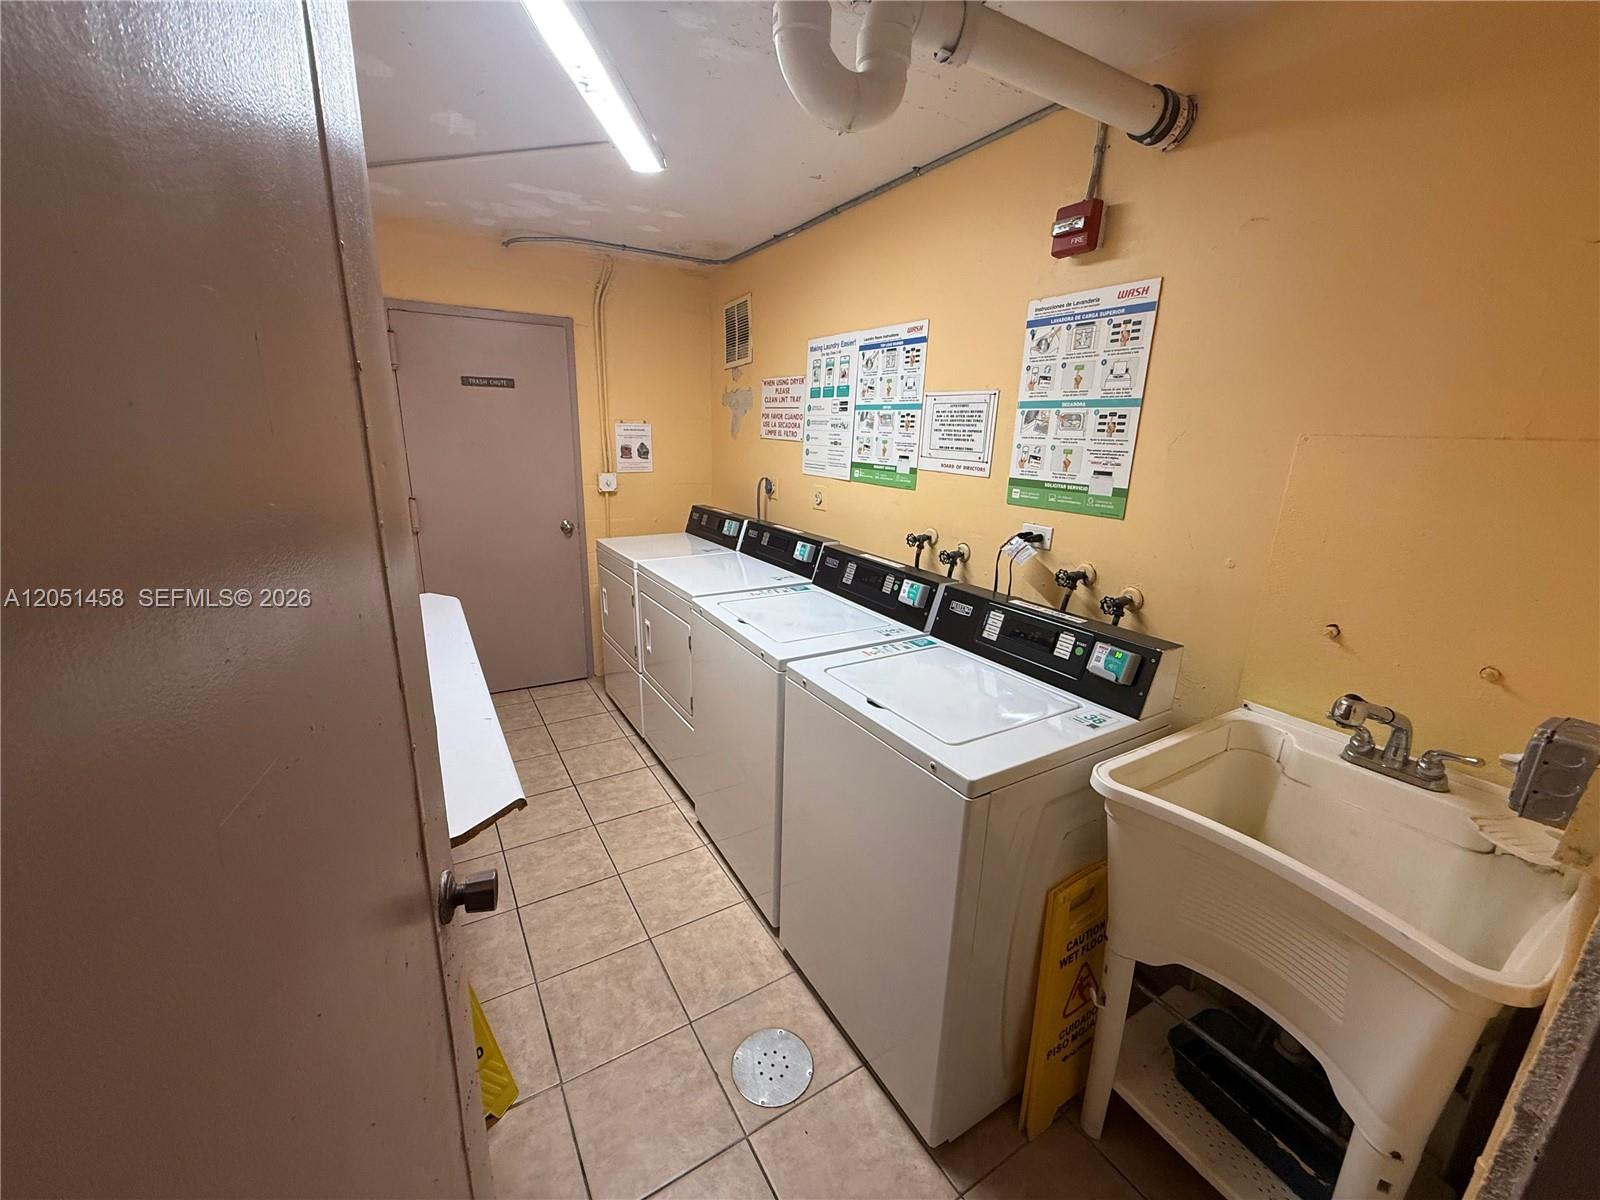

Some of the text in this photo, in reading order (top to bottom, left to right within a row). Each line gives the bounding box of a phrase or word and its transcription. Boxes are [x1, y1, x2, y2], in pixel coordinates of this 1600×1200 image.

[1071, 235, 1087, 245] FIRE
[1117, 286, 1150, 299] WASH
[1034, 302, 1065, 312] Instrucciones
[1050, 315, 1074, 324] LAVADORA
[1081, 312, 1099, 320] CARGA
[1099, 308, 1126, 317] SUPERIOR
[809, 338, 857, 353] Making Laundry Easier!
[776, 378, 789, 386] USING
[790, 377, 805, 385] DRYER
[775, 387, 790, 395] PLEASE
[778, 395, 788, 403] LINT
[789, 395, 802, 403] TRAY
[761, 412, 770, 420] POR
[784, 413, 804, 421] CUANDO
[777, 421, 801, 429] SECADORA
[764, 429, 777, 437] LIMPIE
[783, 430, 798, 438] FILTRO
[962, 465, 986, 473] DIRECTORS
[1044, 482, 1089, 492] SOLICITAR SERVICIO
[1066, 920, 1105, 952] CAUTION
[1059, 949, 1080, 968] WET
[1059, 1006, 1098, 1040] CUIDADO
[1046, 1038, 1070, 1061] PISO
[1071, 1017, 1097, 1042] MOJA
